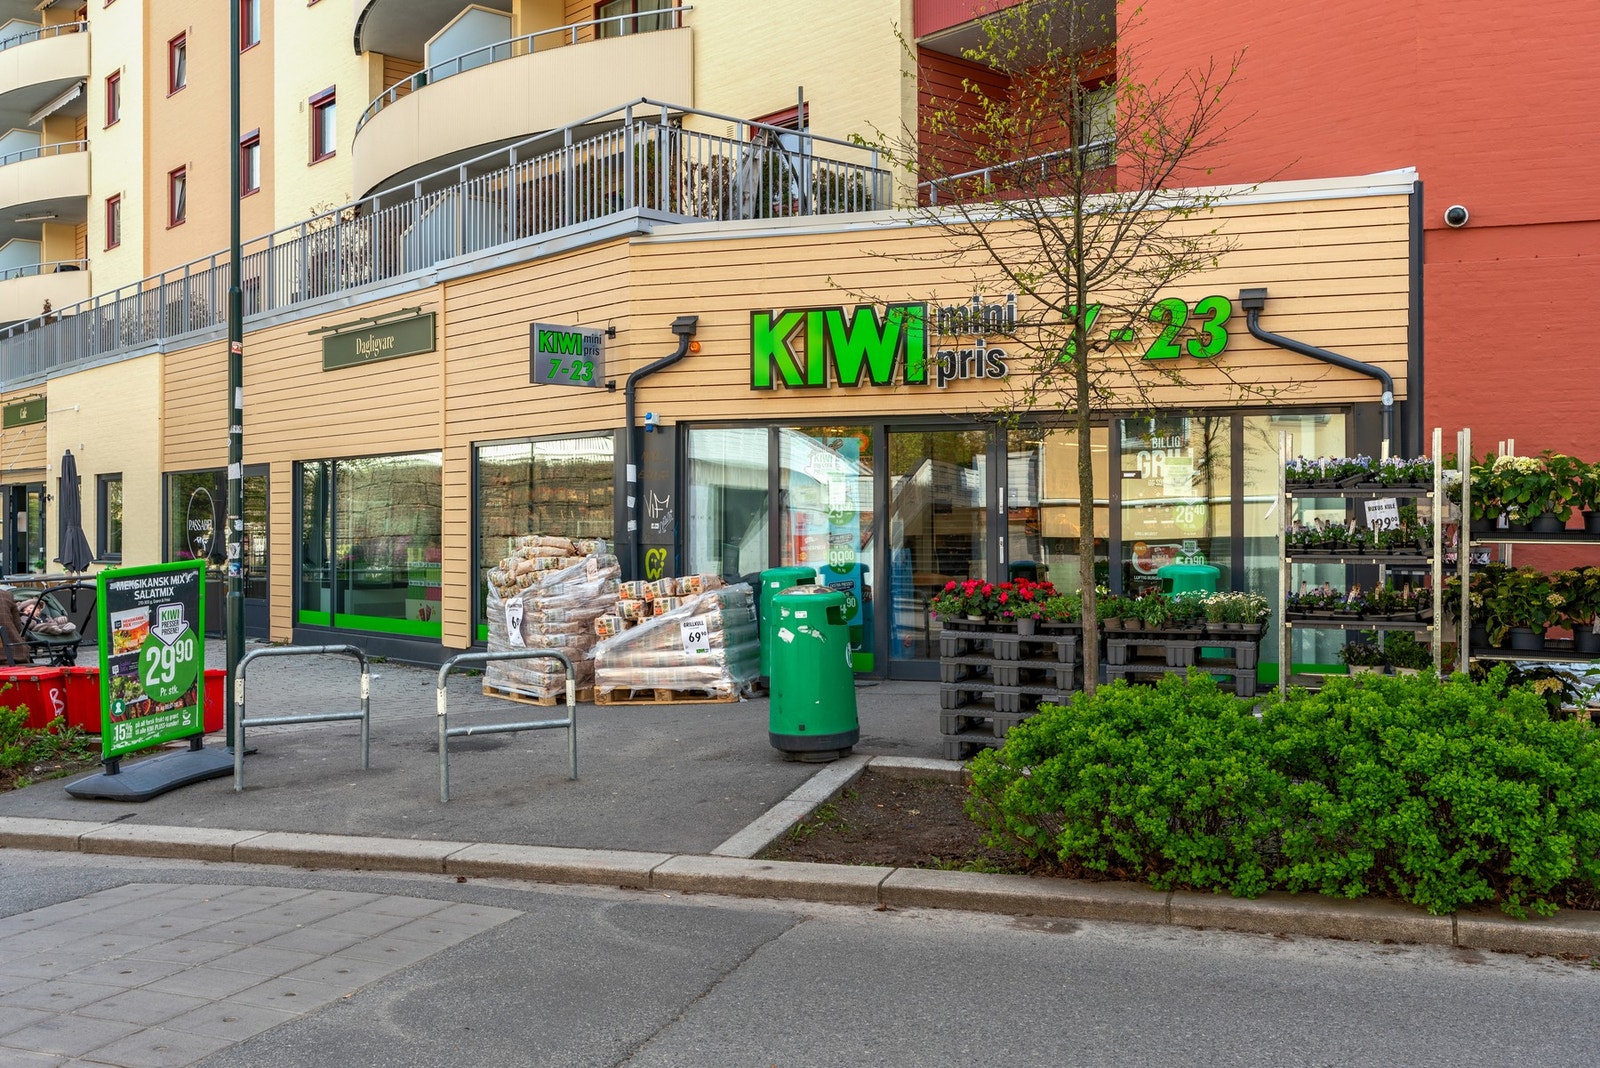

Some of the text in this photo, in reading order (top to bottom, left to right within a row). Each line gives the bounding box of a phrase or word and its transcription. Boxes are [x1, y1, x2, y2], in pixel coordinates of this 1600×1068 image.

[356, 334, 395, 359] Dagligvare
[538, 329, 602, 356] KIWI mini
[583, 345, 600, 357] pris
[750, 292, 1018, 391] KIWI mini
[936, 338, 1009, 389] pris
[134, 587, 175, 601] SALATMIX
[161, 608, 180, 621] KIWI
